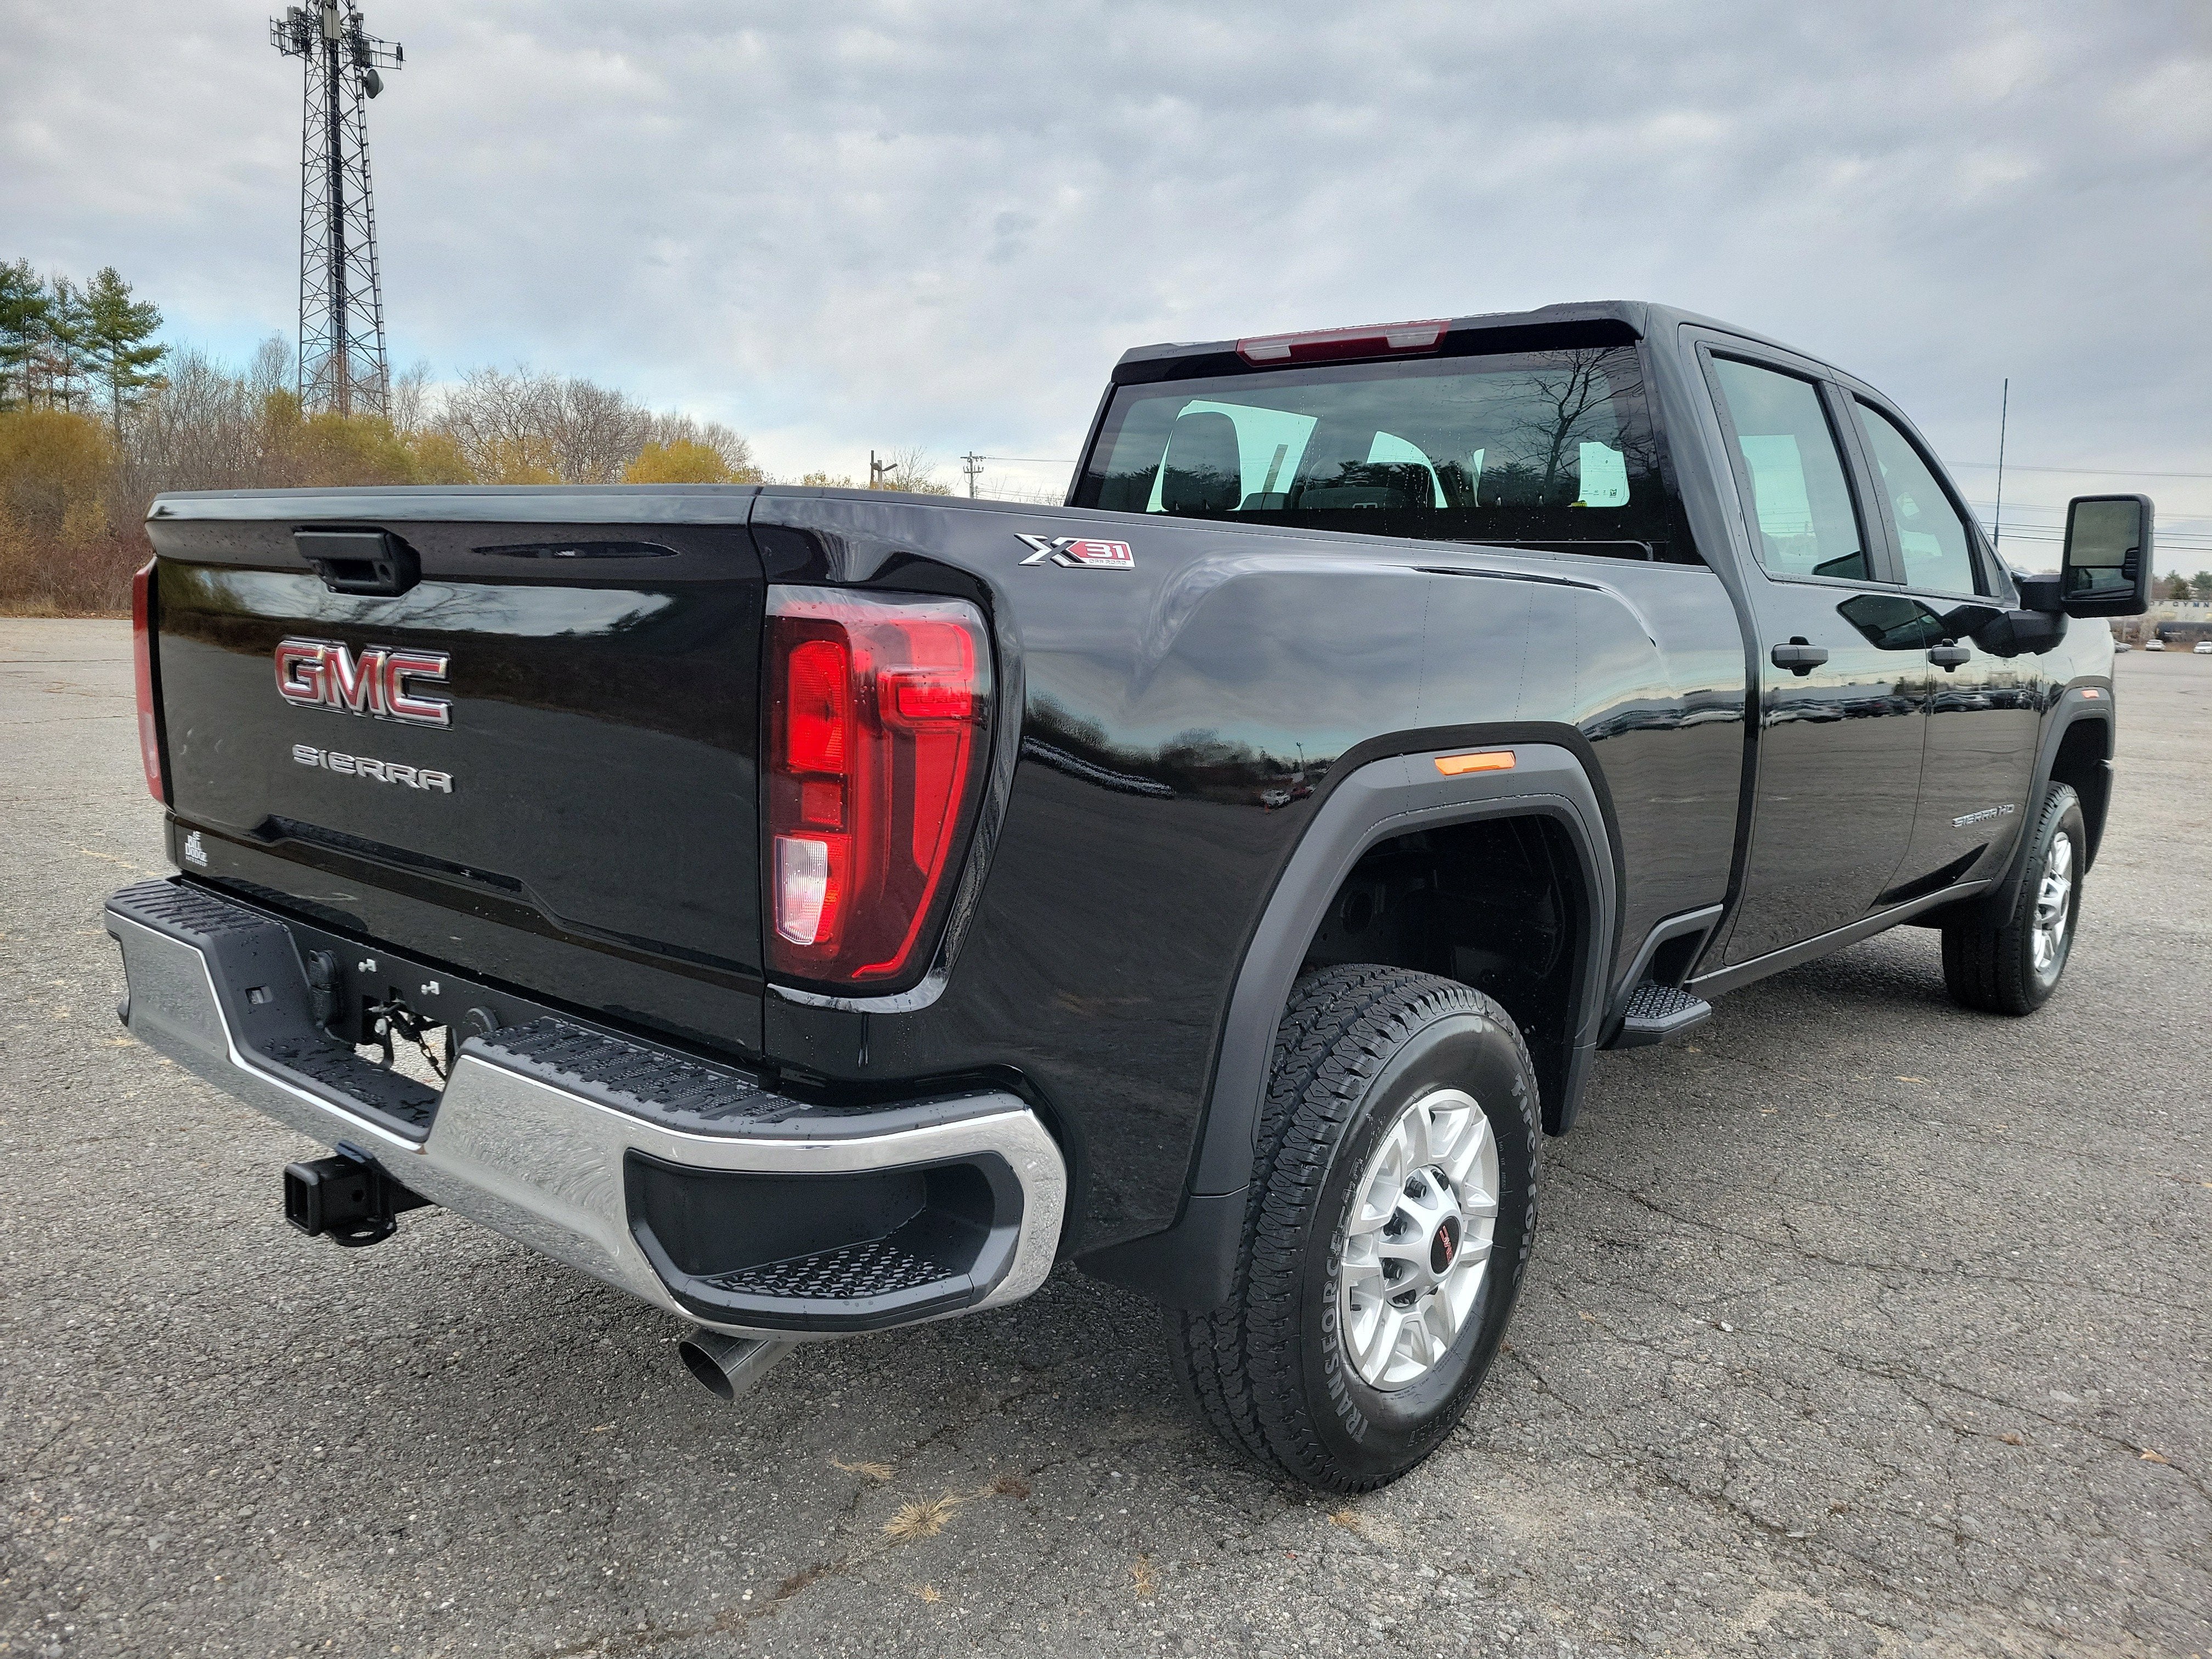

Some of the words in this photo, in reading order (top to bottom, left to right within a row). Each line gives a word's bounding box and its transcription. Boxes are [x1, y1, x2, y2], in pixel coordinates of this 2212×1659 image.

[275, 636, 453, 727] GMC
[292, 743, 455, 794] SIERRA
[1951, 808, 1997, 828] SIERRA
[1997, 804, 2015, 816] HD
[184, 842, 208, 862] DODGE
[187, 834, 202, 851] BILL
[1510, 1073, 1537, 1289] Firestone
[1439, 1225, 1453, 1265] GMC
